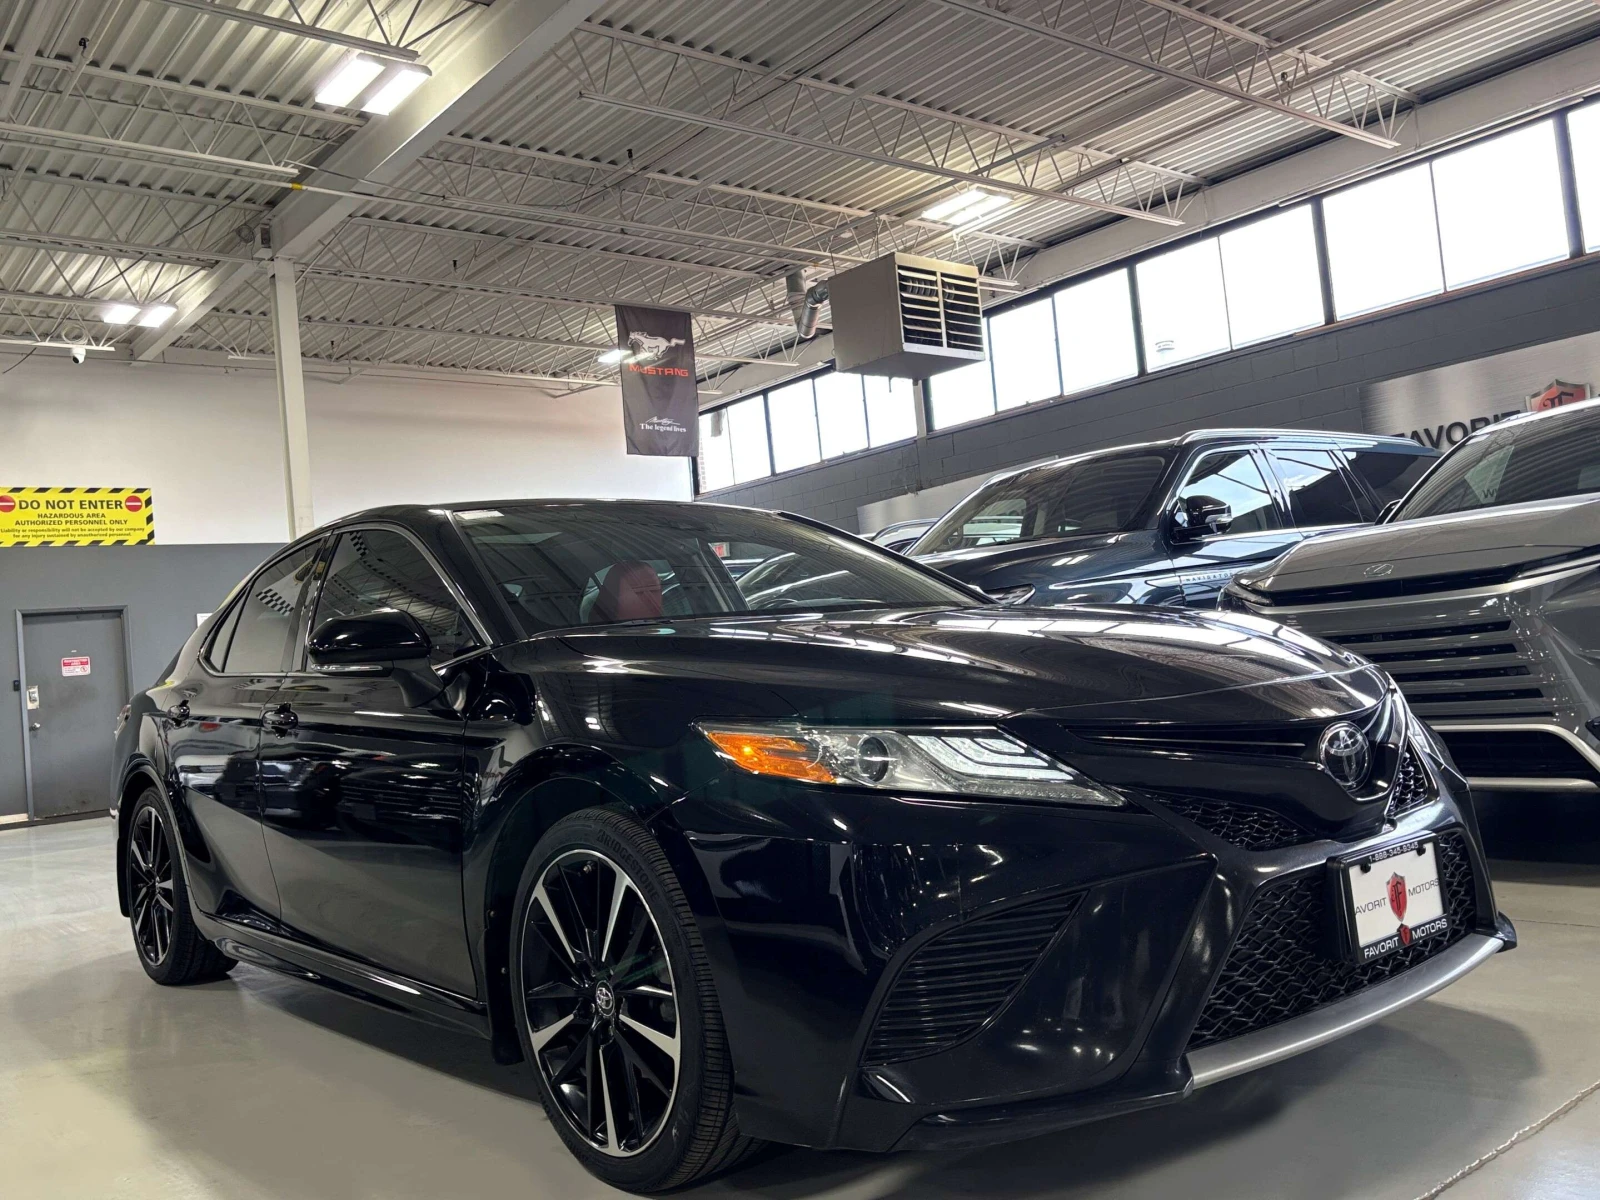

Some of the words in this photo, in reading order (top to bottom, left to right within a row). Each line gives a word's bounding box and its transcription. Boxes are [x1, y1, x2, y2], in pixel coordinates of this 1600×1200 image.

[629, 363, 689, 377] MUSTANG
[655, 424, 673, 432] legend
[18, 499, 40, 510] DO
[45, 499, 75, 510] NOT
[79, 499, 123, 510] ENTER
[1407, 877, 1440, 897] MOTORS
[1354, 897, 1387, 916] AVORIT
[1364, 936, 1399, 959] FAVORIT
[1412, 918, 1448, 940] MOTORS
